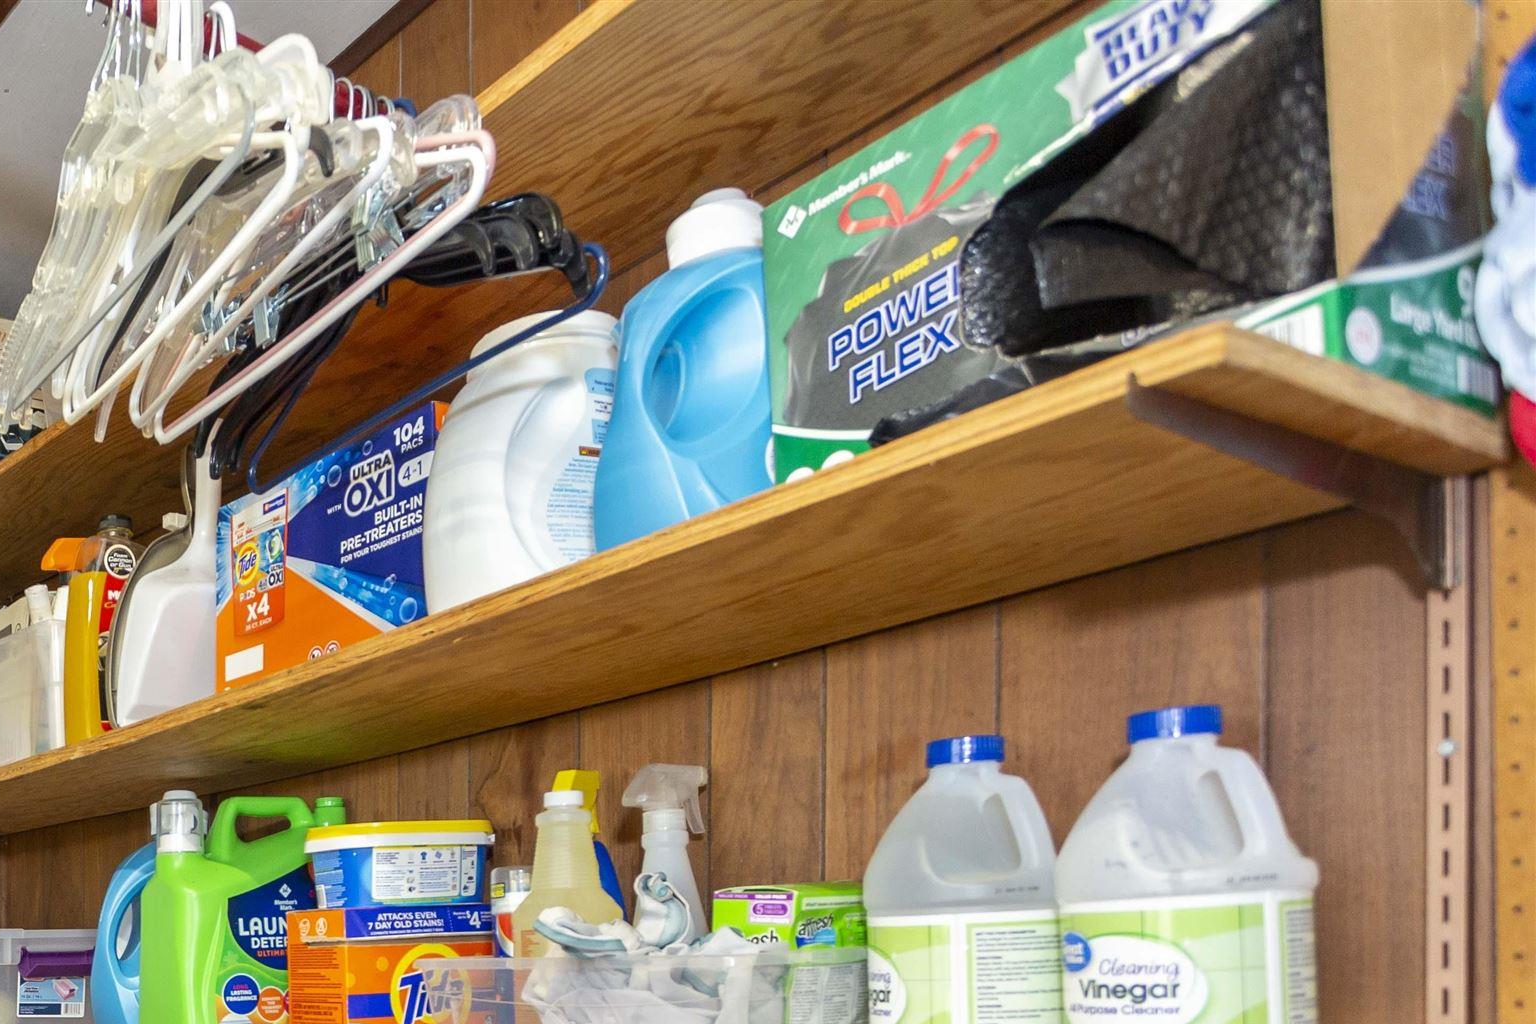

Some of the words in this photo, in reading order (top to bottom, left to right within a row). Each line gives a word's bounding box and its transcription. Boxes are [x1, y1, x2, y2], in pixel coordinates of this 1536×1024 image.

[1101, 0, 1210, 58] HEAV
[1107, 11, 1205, 80] DUTY
[844, 275, 891, 314] DOUBLE
[849, 308, 960, 405] FLEX
[393, 416, 425, 447] 104
[401, 435, 424, 454] PACS
[351, 455, 393, 482] ULTRA
[345, 467, 394, 516] OXI
[327, 503, 342, 515] WITH
[374, 493, 423, 526] BUILT-IN
[340, 510, 424, 555] PRE-TREATERS
[340, 554, 353, 565] FOR
[353, 548, 370, 561] YOUR
[370, 537, 401, 555] TOUGHEST
[402, 526, 424, 543] STAINS
[239, 551, 257, 579] Tide
[368, 922, 373, 930] 7
[374, 921, 394, 930] DAY
[395, 920, 412, 929] OLD
[413, 919, 444, 928] STAINS!
[377, 912, 414, 921] ATTACKS
[415, 911, 437, 920] EVEN
[798, 912, 834, 937] affresh
[1098, 957, 1180, 980] Cleaning
[1078, 979, 1181, 1004] Vinegar
[1121, 1004, 1181, 1015] Cleaner
